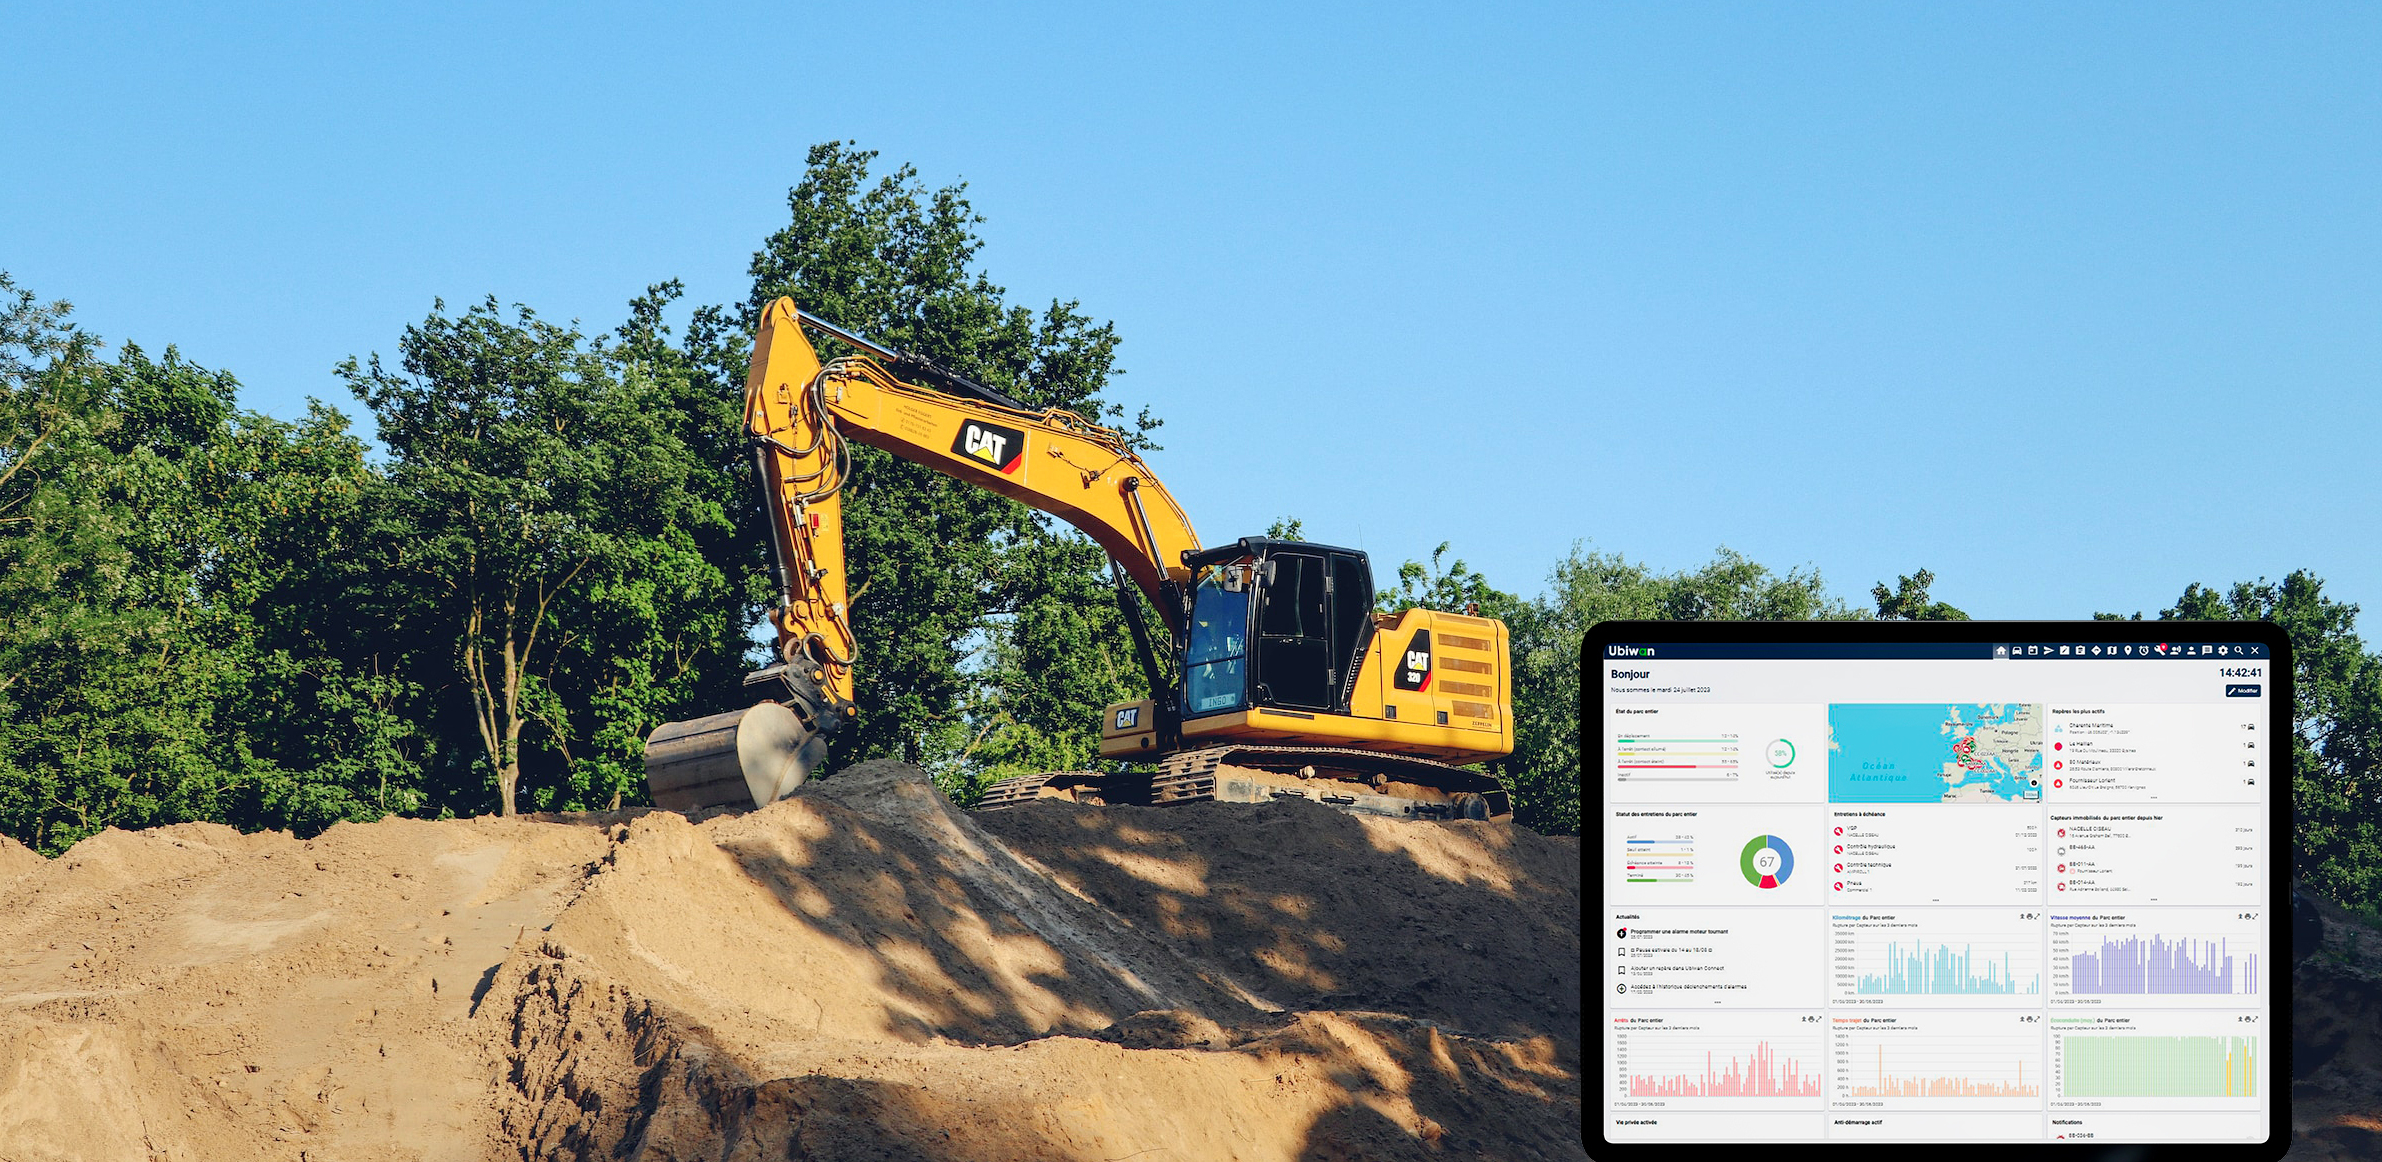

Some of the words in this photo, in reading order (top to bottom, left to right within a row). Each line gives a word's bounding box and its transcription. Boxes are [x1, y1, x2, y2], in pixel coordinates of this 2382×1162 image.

[965, 424, 1006, 465] CAT
[1609, 645, 1655, 656] Ubiwan
[1407, 651, 1429, 671] CAT
[1407, 672, 1420, 683] 320
[1611, 670, 1650, 681] Bonjour
[2220, 668, 2261, 677] 14:42:41
[1208, 697, 1227, 706] INGO
[1118, 709, 1137, 728] CAT
[1862, 761, 1894, 770] Océan
[1849, 773, 1908, 783] Atlantique
[1760, 857, 1774, 867] 67
